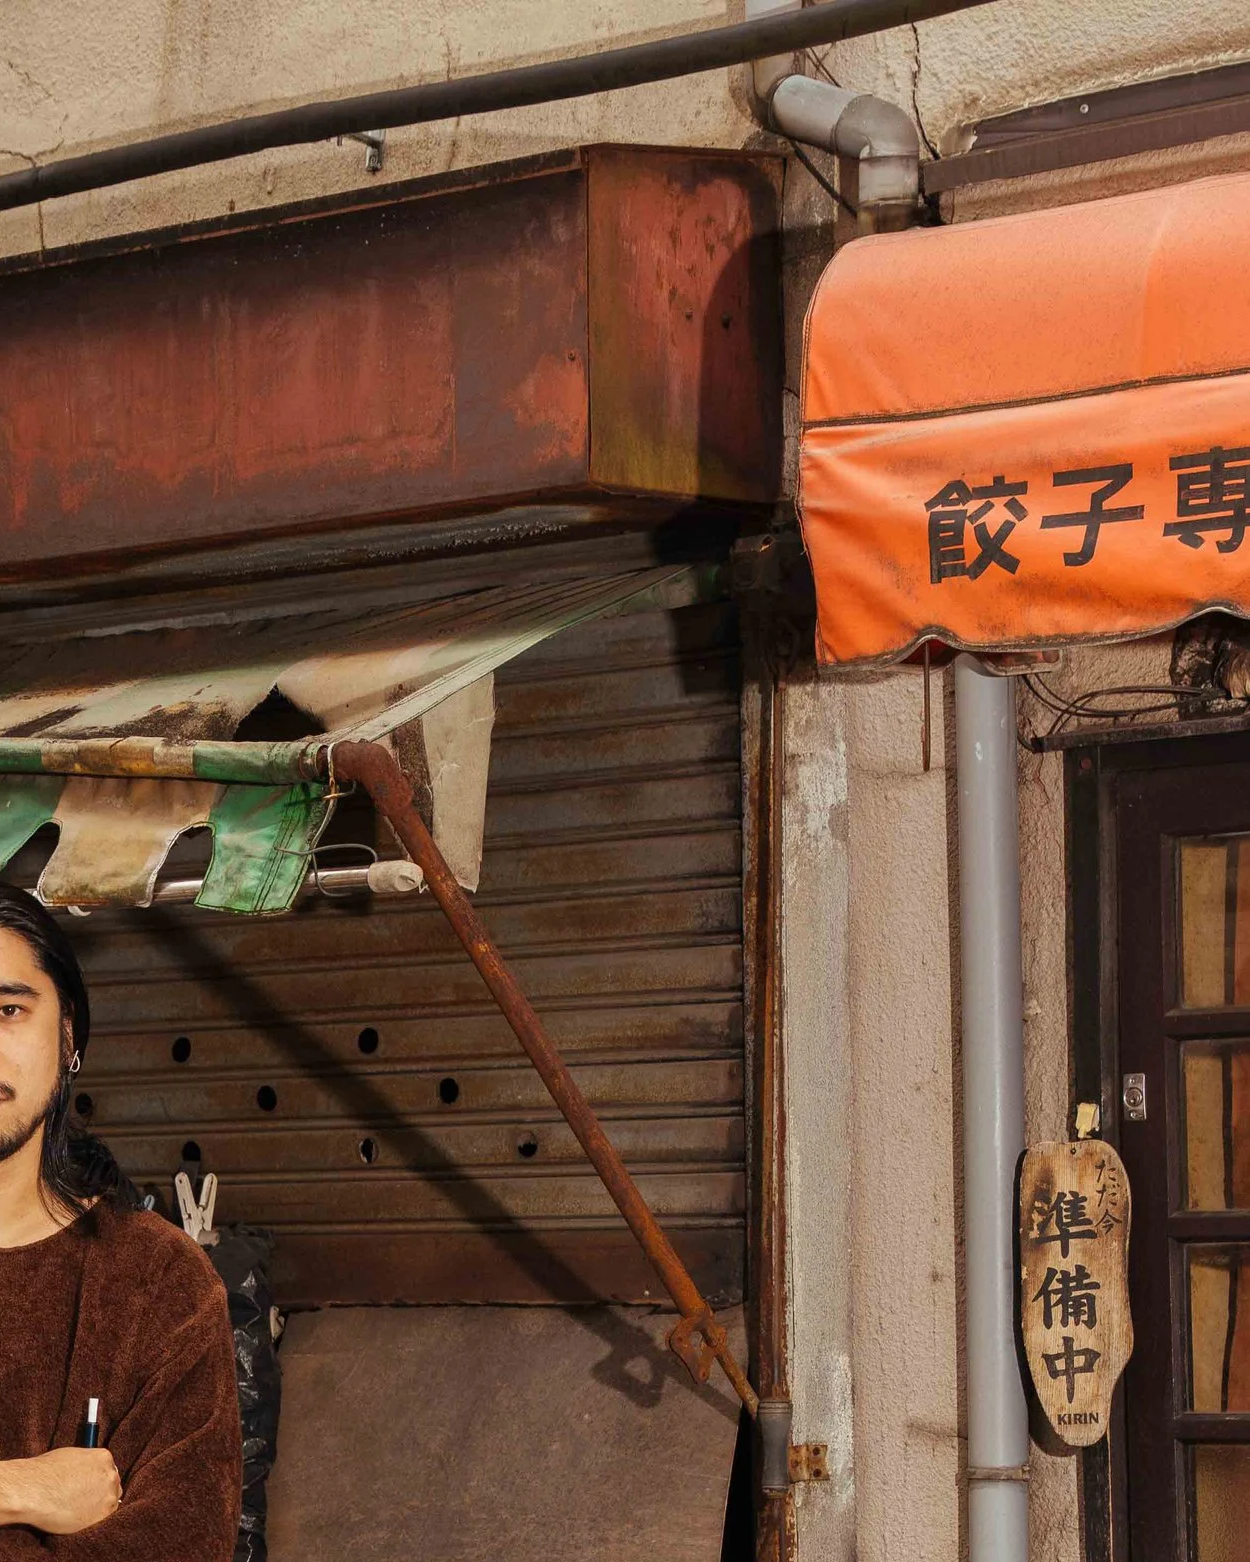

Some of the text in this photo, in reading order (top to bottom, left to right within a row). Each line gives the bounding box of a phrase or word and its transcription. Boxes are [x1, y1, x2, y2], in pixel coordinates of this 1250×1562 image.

[924, 446, 1250, 584] 餃子専
[1094, 1158, 1123, 1236] ただ今
[1030, 1190, 1102, 1404] 準備中
[1056, 1411, 1100, 1426] KIRIN
